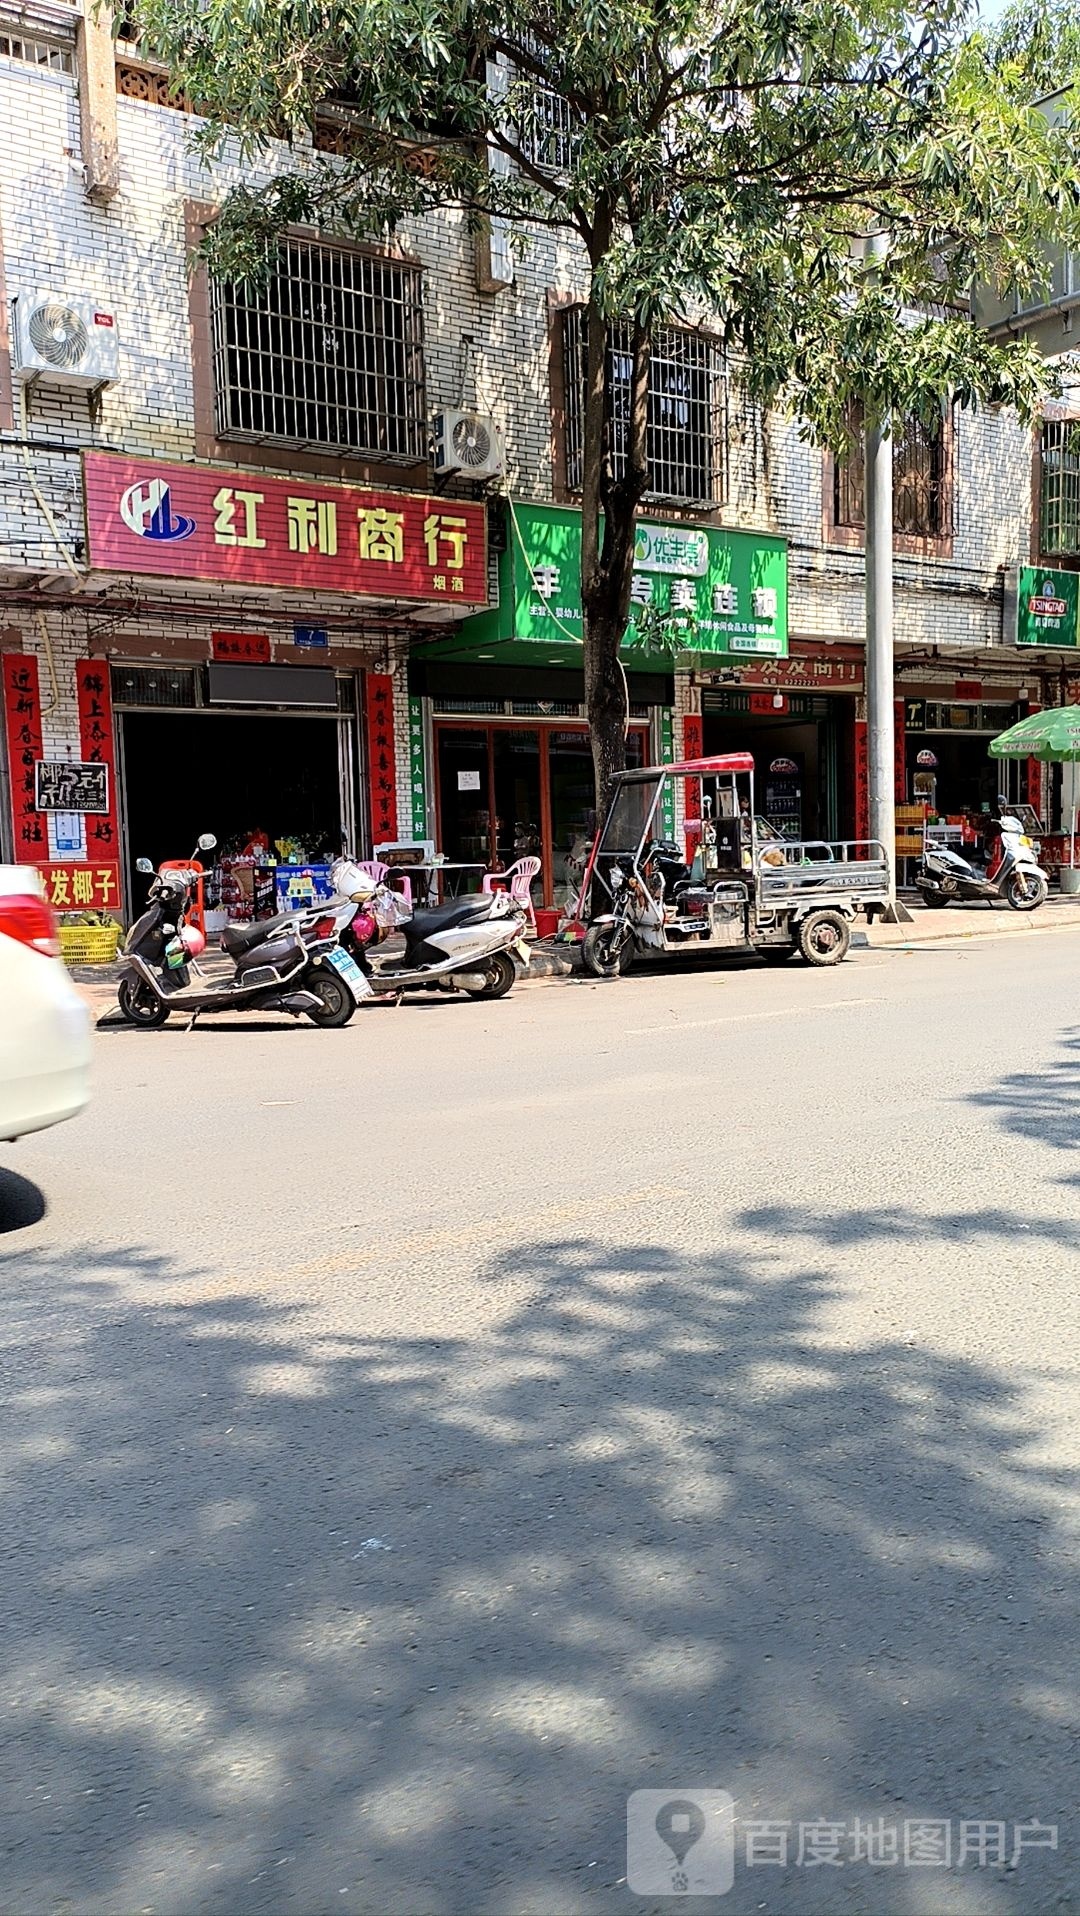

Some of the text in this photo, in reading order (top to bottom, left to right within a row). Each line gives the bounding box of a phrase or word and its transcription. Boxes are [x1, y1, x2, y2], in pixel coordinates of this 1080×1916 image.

[96, 316, 111, 324] TCL
[213, 488, 468, 570] 红利商行
[653, 536, 698, 560] 优生活
[655, 556, 678, 565] BEST
[433, 574, 465, 593] 烟酒
[532, 563, 777, 620] 羊专卖连锁
[1030, 599, 1065, 614] TSINGTAO
[411, 706, 425, 834] 让更多人喝上好
